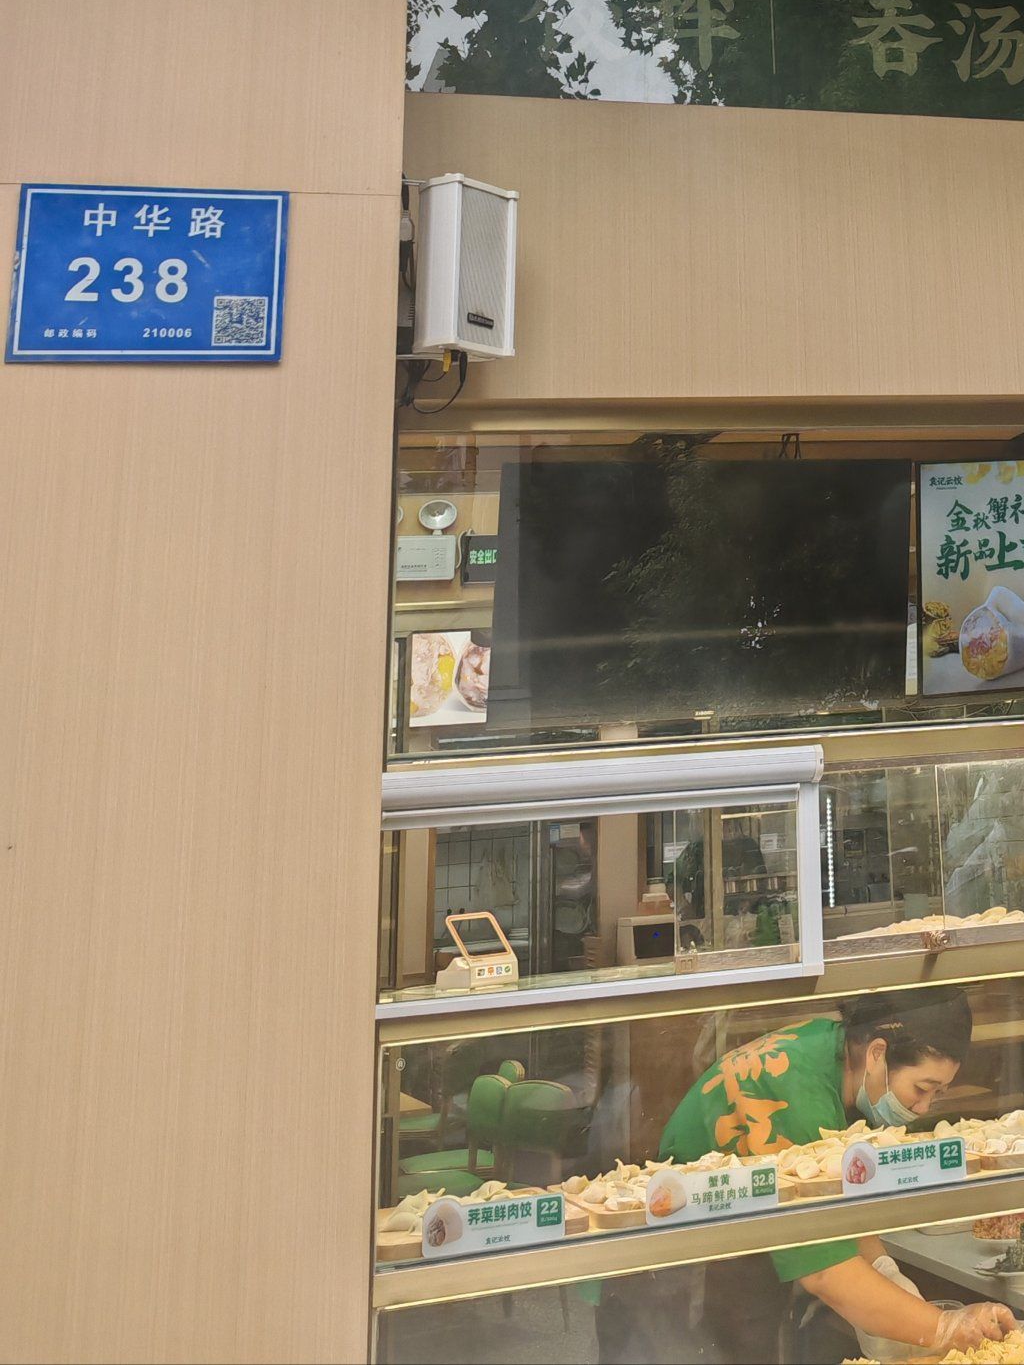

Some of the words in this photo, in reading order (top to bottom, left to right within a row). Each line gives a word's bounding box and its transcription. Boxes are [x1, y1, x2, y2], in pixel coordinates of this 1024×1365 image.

[83, 202, 225, 239] 中华路
[64, 256, 189, 303] 238
[43, 328, 97, 339] 邮政编码
[142, 328, 193, 338] 210006
[878, 1144, 937, 1165] 玉米鲜肉饺
[942, 1144, 959, 1158] 22
[708, 1174, 731, 1188] 蟹黄
[753, 1172, 775, 1187] 32.8
[691, 1186, 748, 1205] 马蹄鲜肉饺
[467, 1201, 532, 1226] 荠菜鲜肉饺
[540, 1200, 559, 1214] 22
